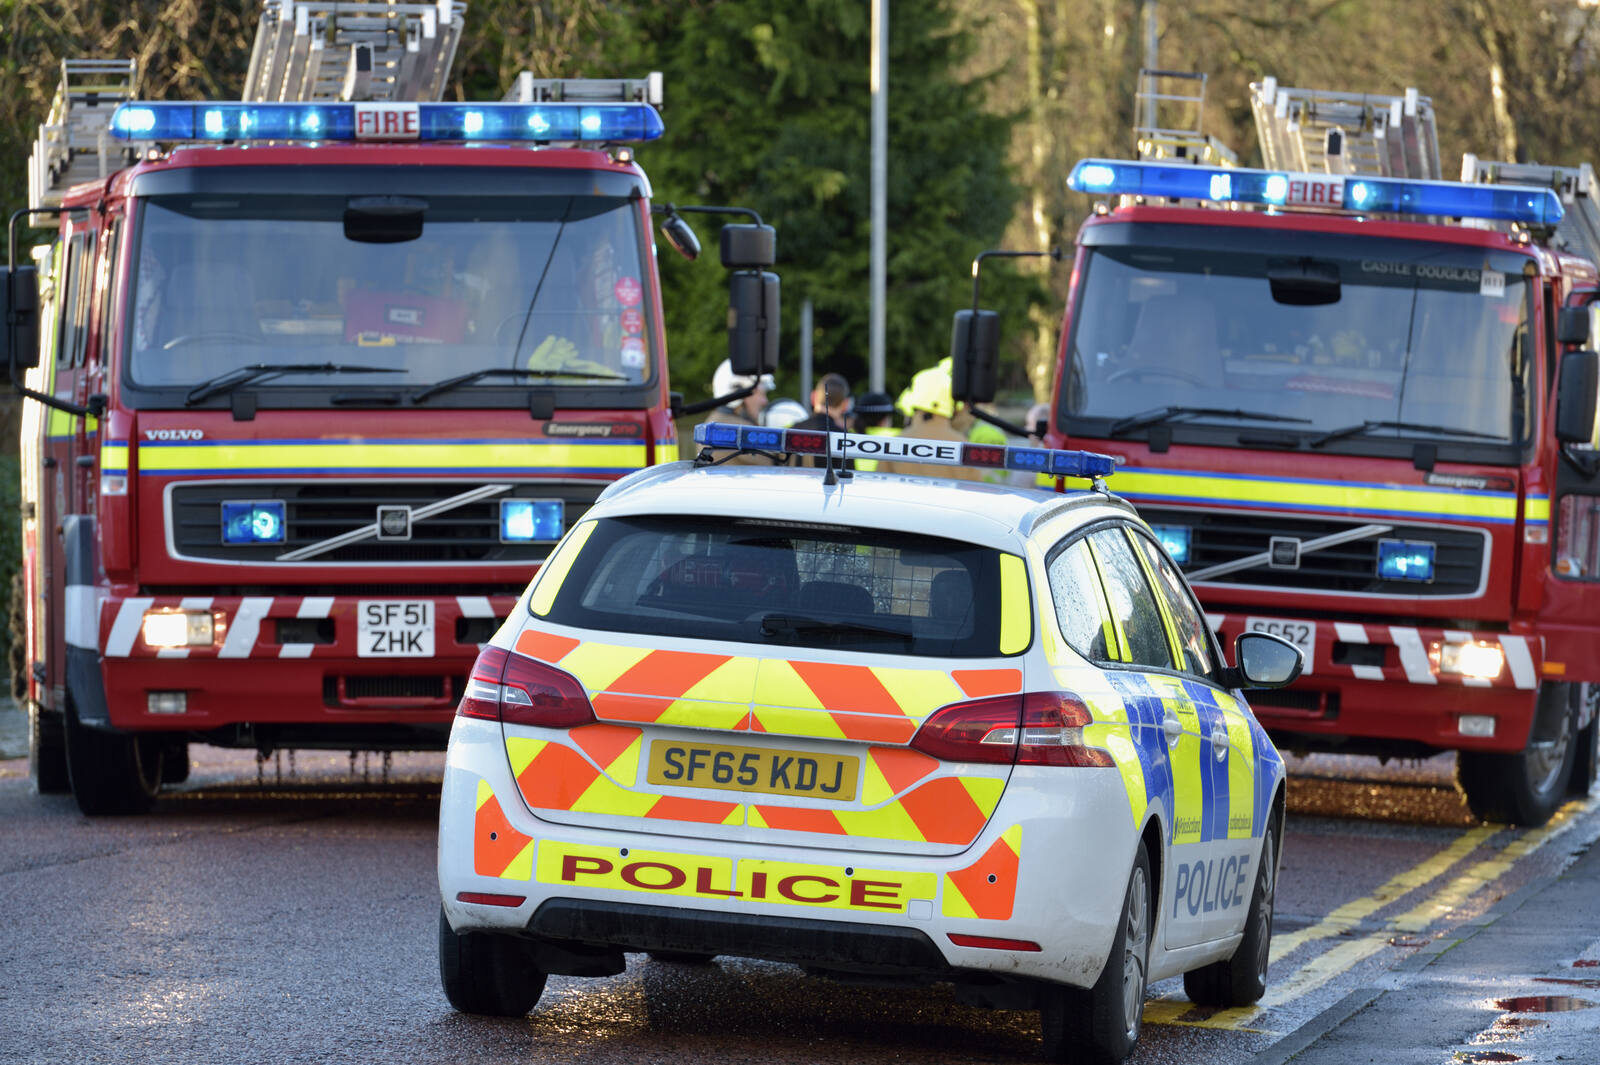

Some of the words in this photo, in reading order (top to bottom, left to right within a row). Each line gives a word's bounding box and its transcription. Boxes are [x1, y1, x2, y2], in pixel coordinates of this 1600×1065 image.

[358, 111, 417, 134] FIRE
[1288, 181, 1342, 205] FIRE
[1360, 259, 1411, 276] CASTLE
[1416, 264, 1480, 283] DOUGLAS
[144, 429, 204, 441] VOLVO
[837, 438, 956, 460] POLICE
[367, 604, 427, 626] SF51
[371, 631, 423, 653] ZHK
[663, 747, 761, 786] SF65
[769, 755, 844, 794] KDJ
[561, 854, 903, 910] POLICE
[1172, 855, 1250, 919] POLICE
